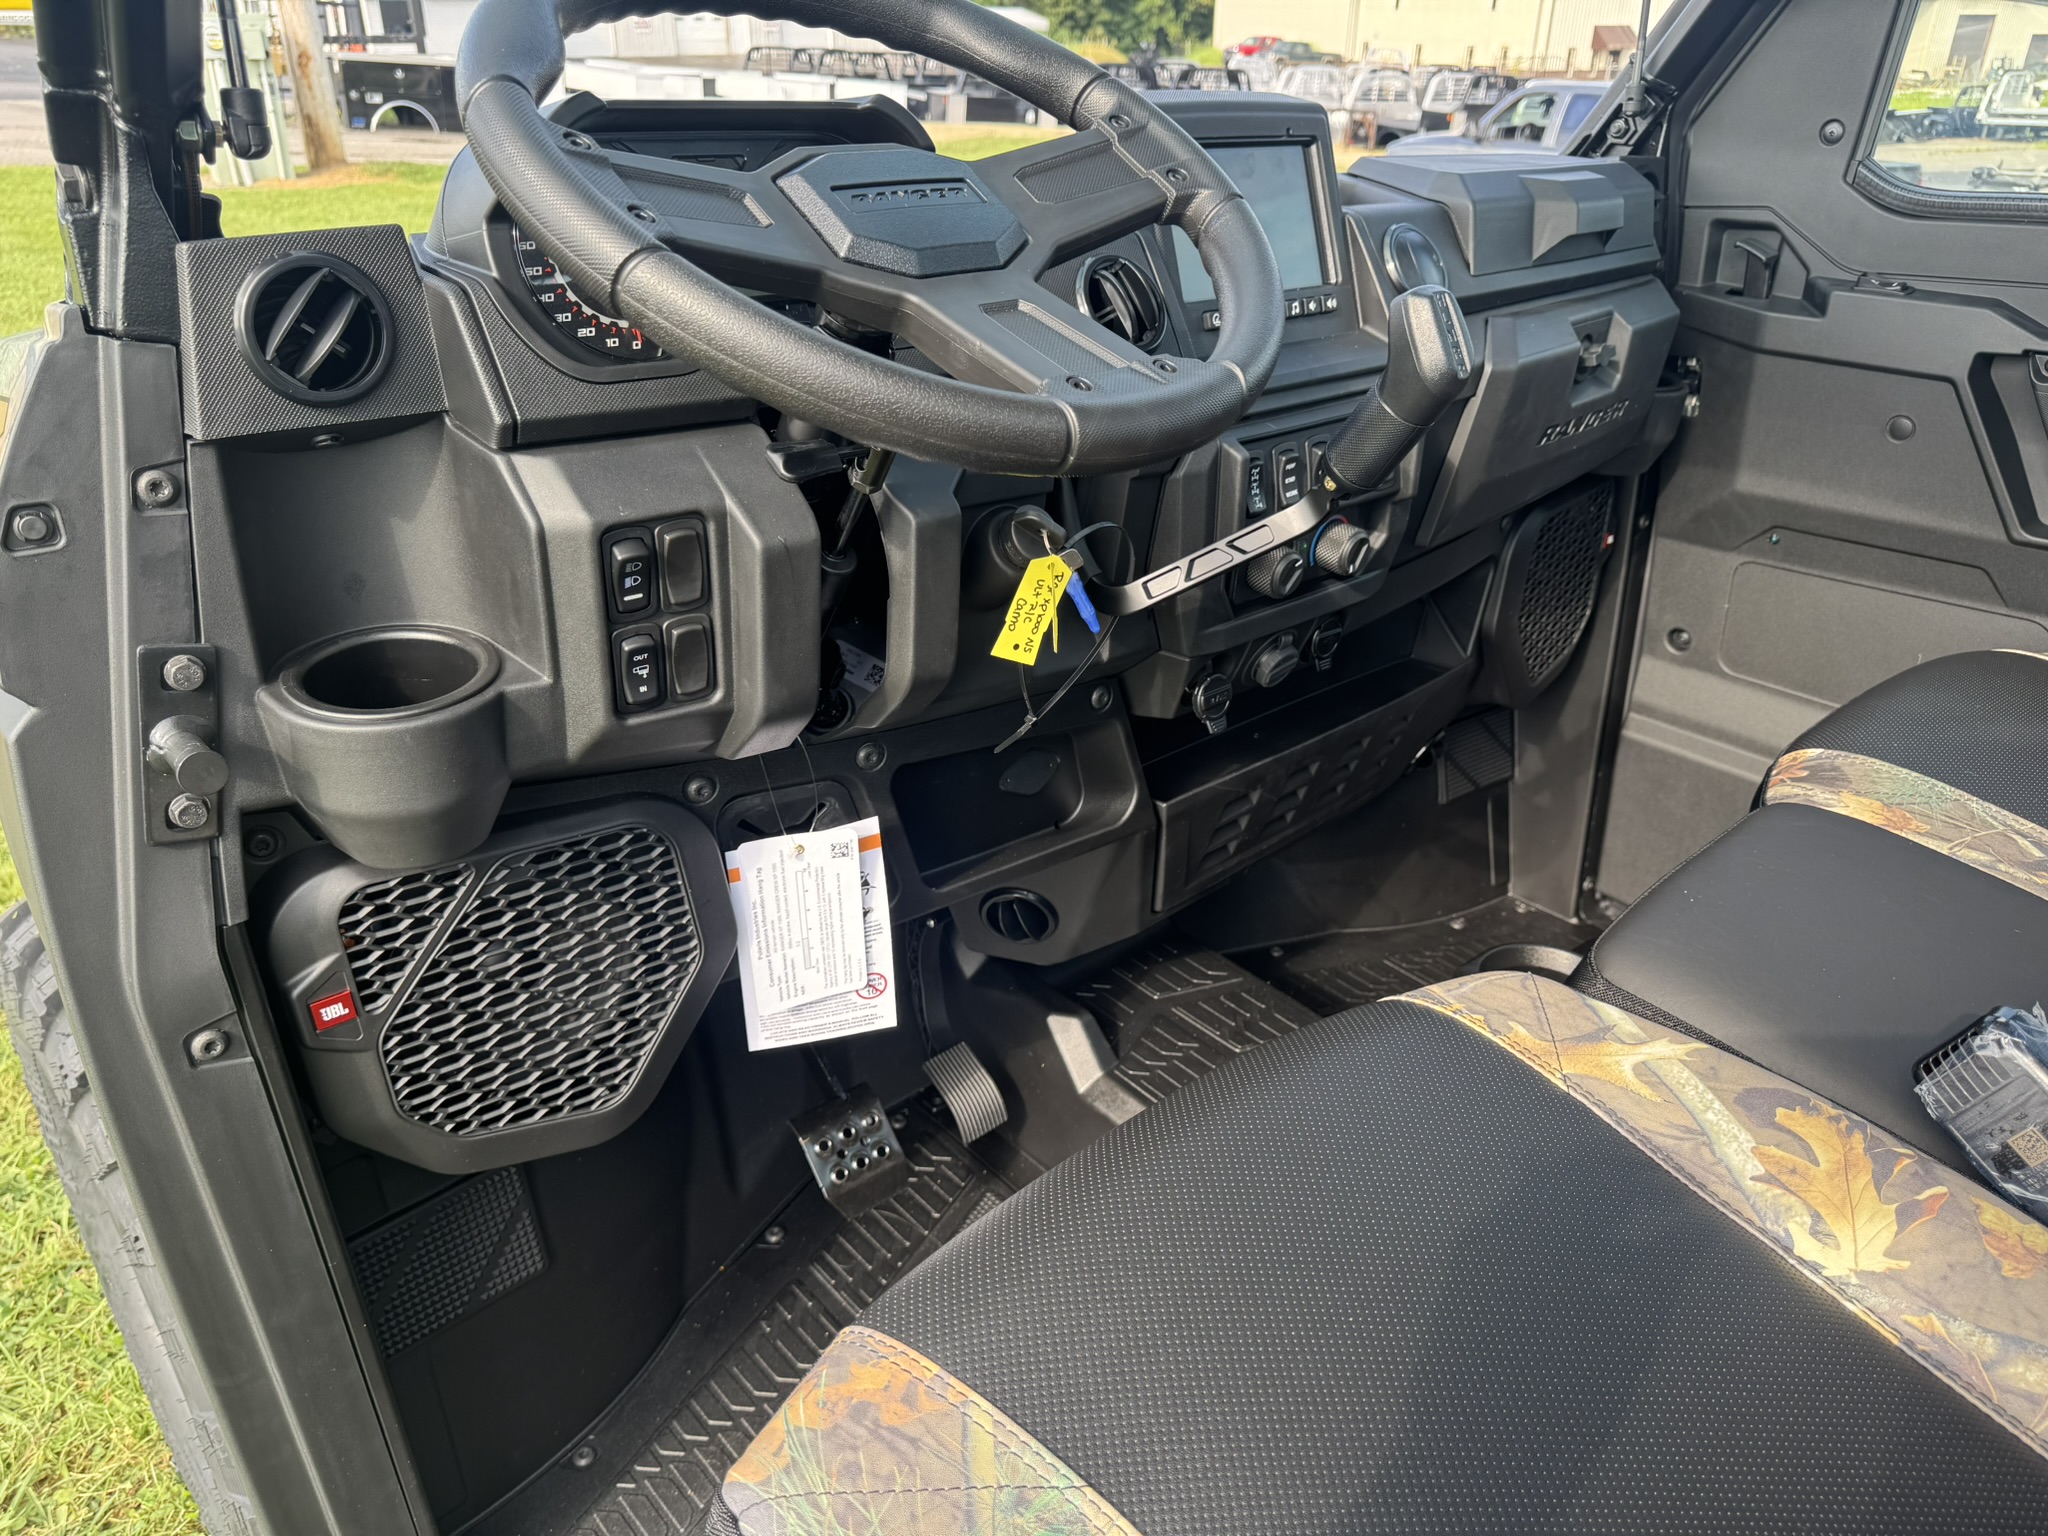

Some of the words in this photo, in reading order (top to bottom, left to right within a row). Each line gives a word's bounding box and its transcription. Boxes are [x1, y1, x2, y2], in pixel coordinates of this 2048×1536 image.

[851, 187, 968, 204] RANGER
[539, 292, 555, 303] 40
[554, 312, 572, 322] 30
[577, 327, 596, 338] 20
[605, 337, 619, 348] 10
[632, 341, 642, 350] 0
[1535, 399, 1629, 448] RANGER
[633, 653, 649, 662] OUT
[639, 685, 648, 693] IN
[759, 896, 768, 927] Information
[753, 912, 761, 939] Industries
[763, 929, 771, 957] Emissions
[767, 959, 775, 987] Consumer
[319, 1001, 350, 1022] JBL
